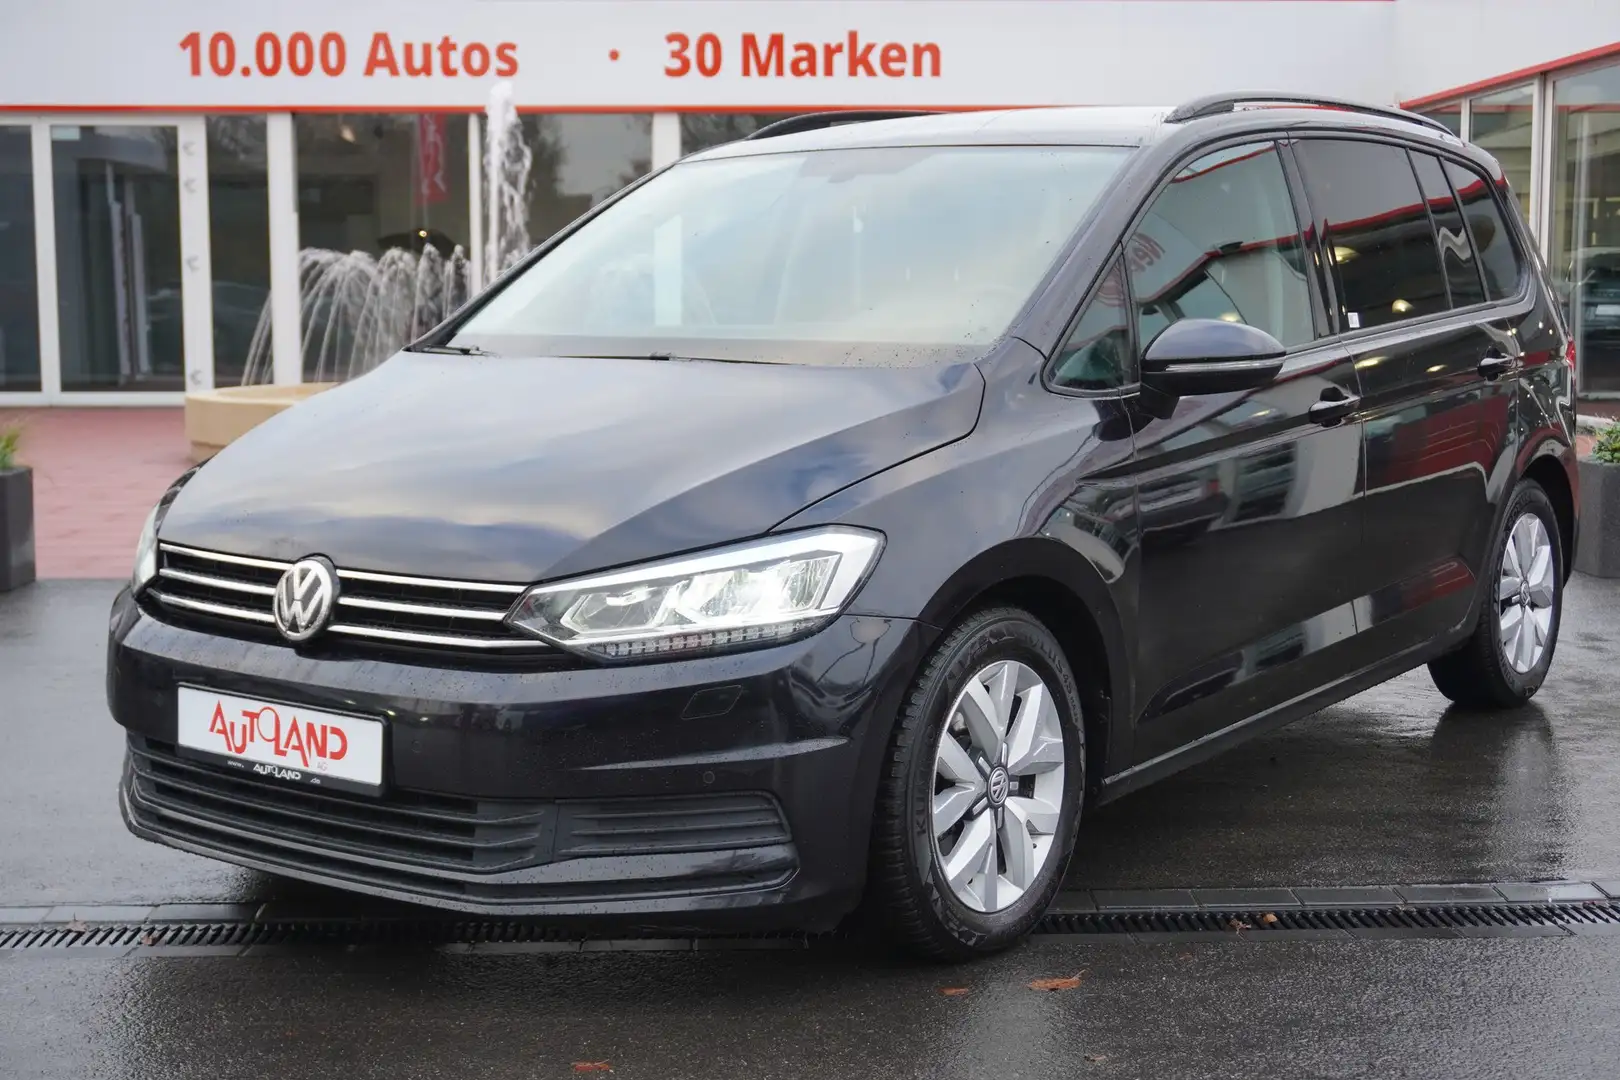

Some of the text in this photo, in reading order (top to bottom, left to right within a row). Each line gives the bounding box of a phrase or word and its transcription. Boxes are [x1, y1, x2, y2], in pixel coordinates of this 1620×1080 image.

[179, 30, 942, 79] 10.000 Autos 30 Marken
[209, 700, 348, 768] AUTOLAND
[253, 763, 301, 780] AUTOLAND
